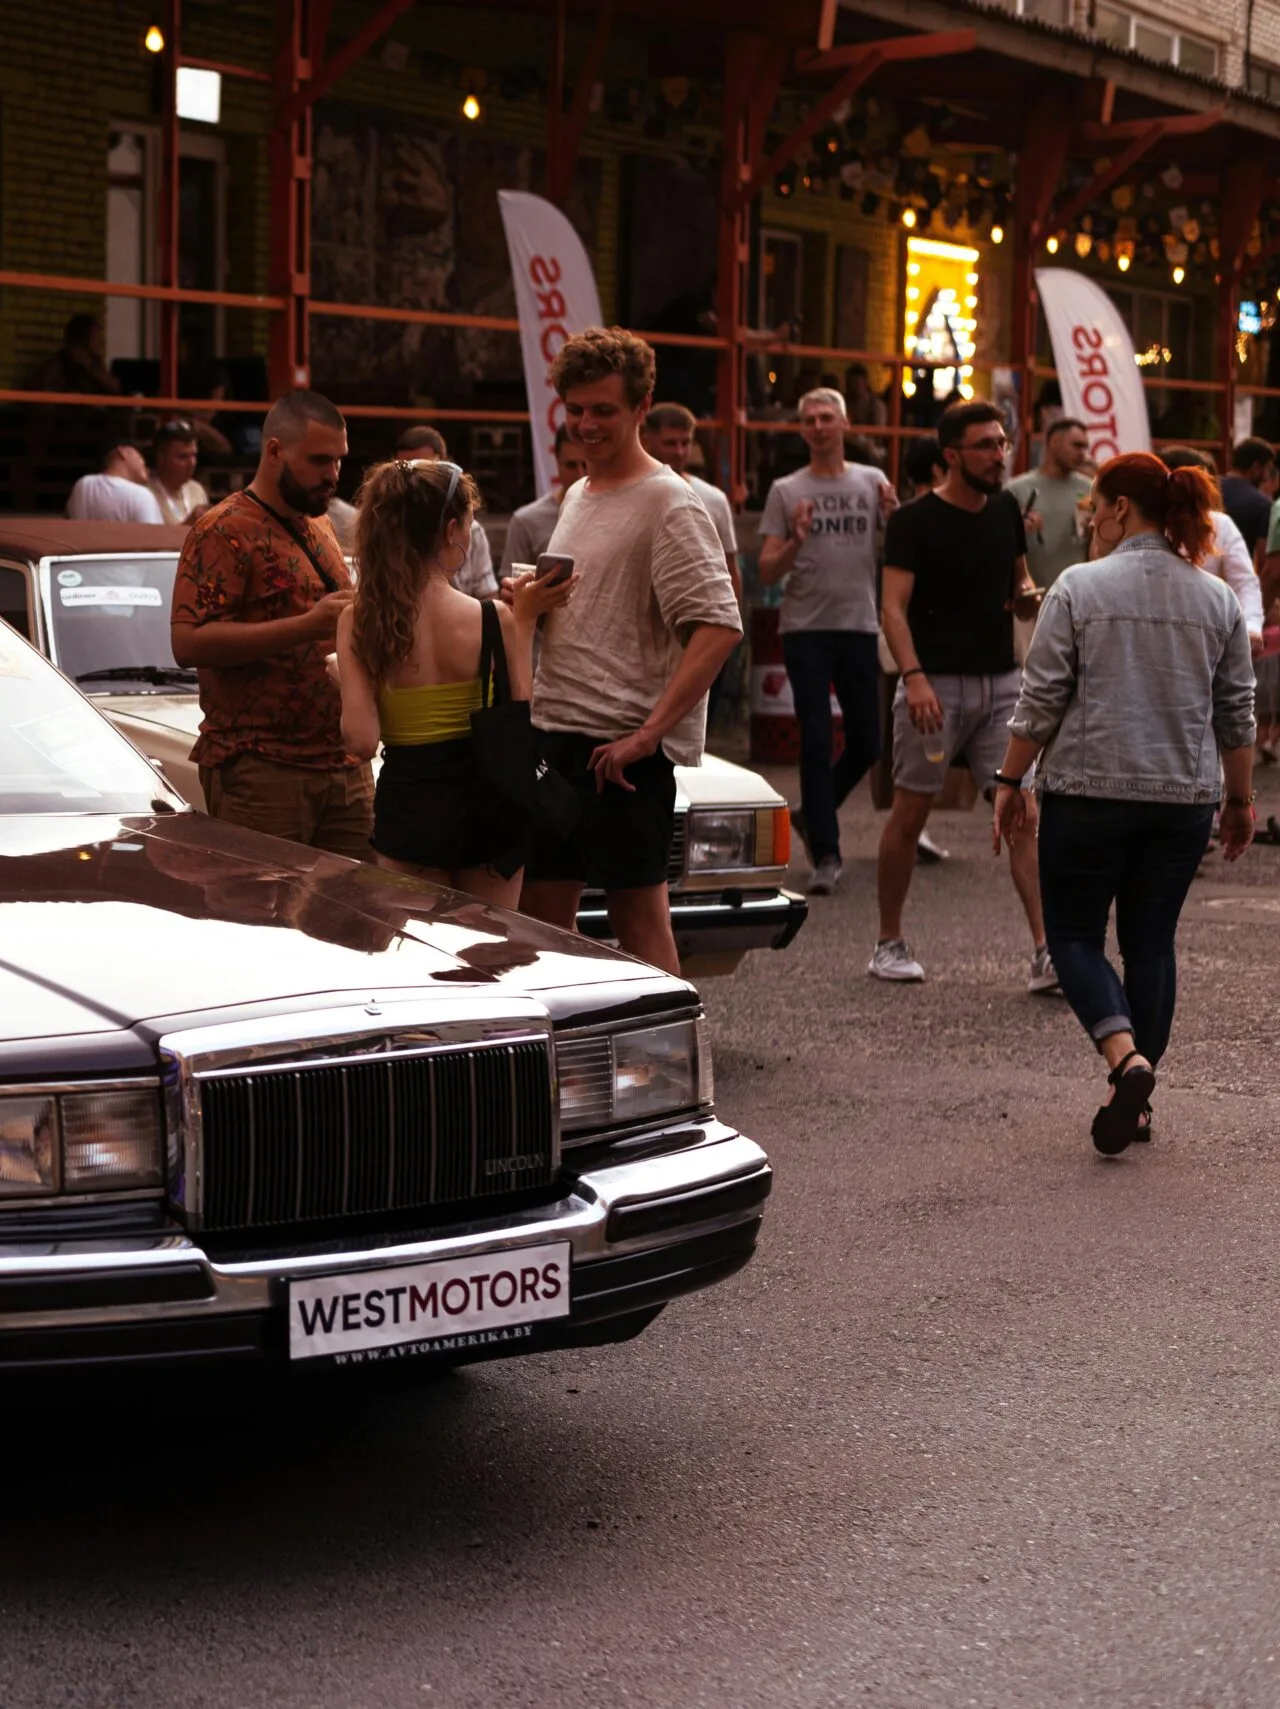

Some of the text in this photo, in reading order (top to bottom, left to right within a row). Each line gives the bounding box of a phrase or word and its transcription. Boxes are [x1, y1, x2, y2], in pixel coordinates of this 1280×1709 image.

[810, 516, 867, 535] ONES
[484, 1152, 544, 1176] LINCOLN
[298, 1263, 562, 1336] WESTMOTORS
[334, 1325, 534, 1365] WWW.AVTOAMERIKA.BY
